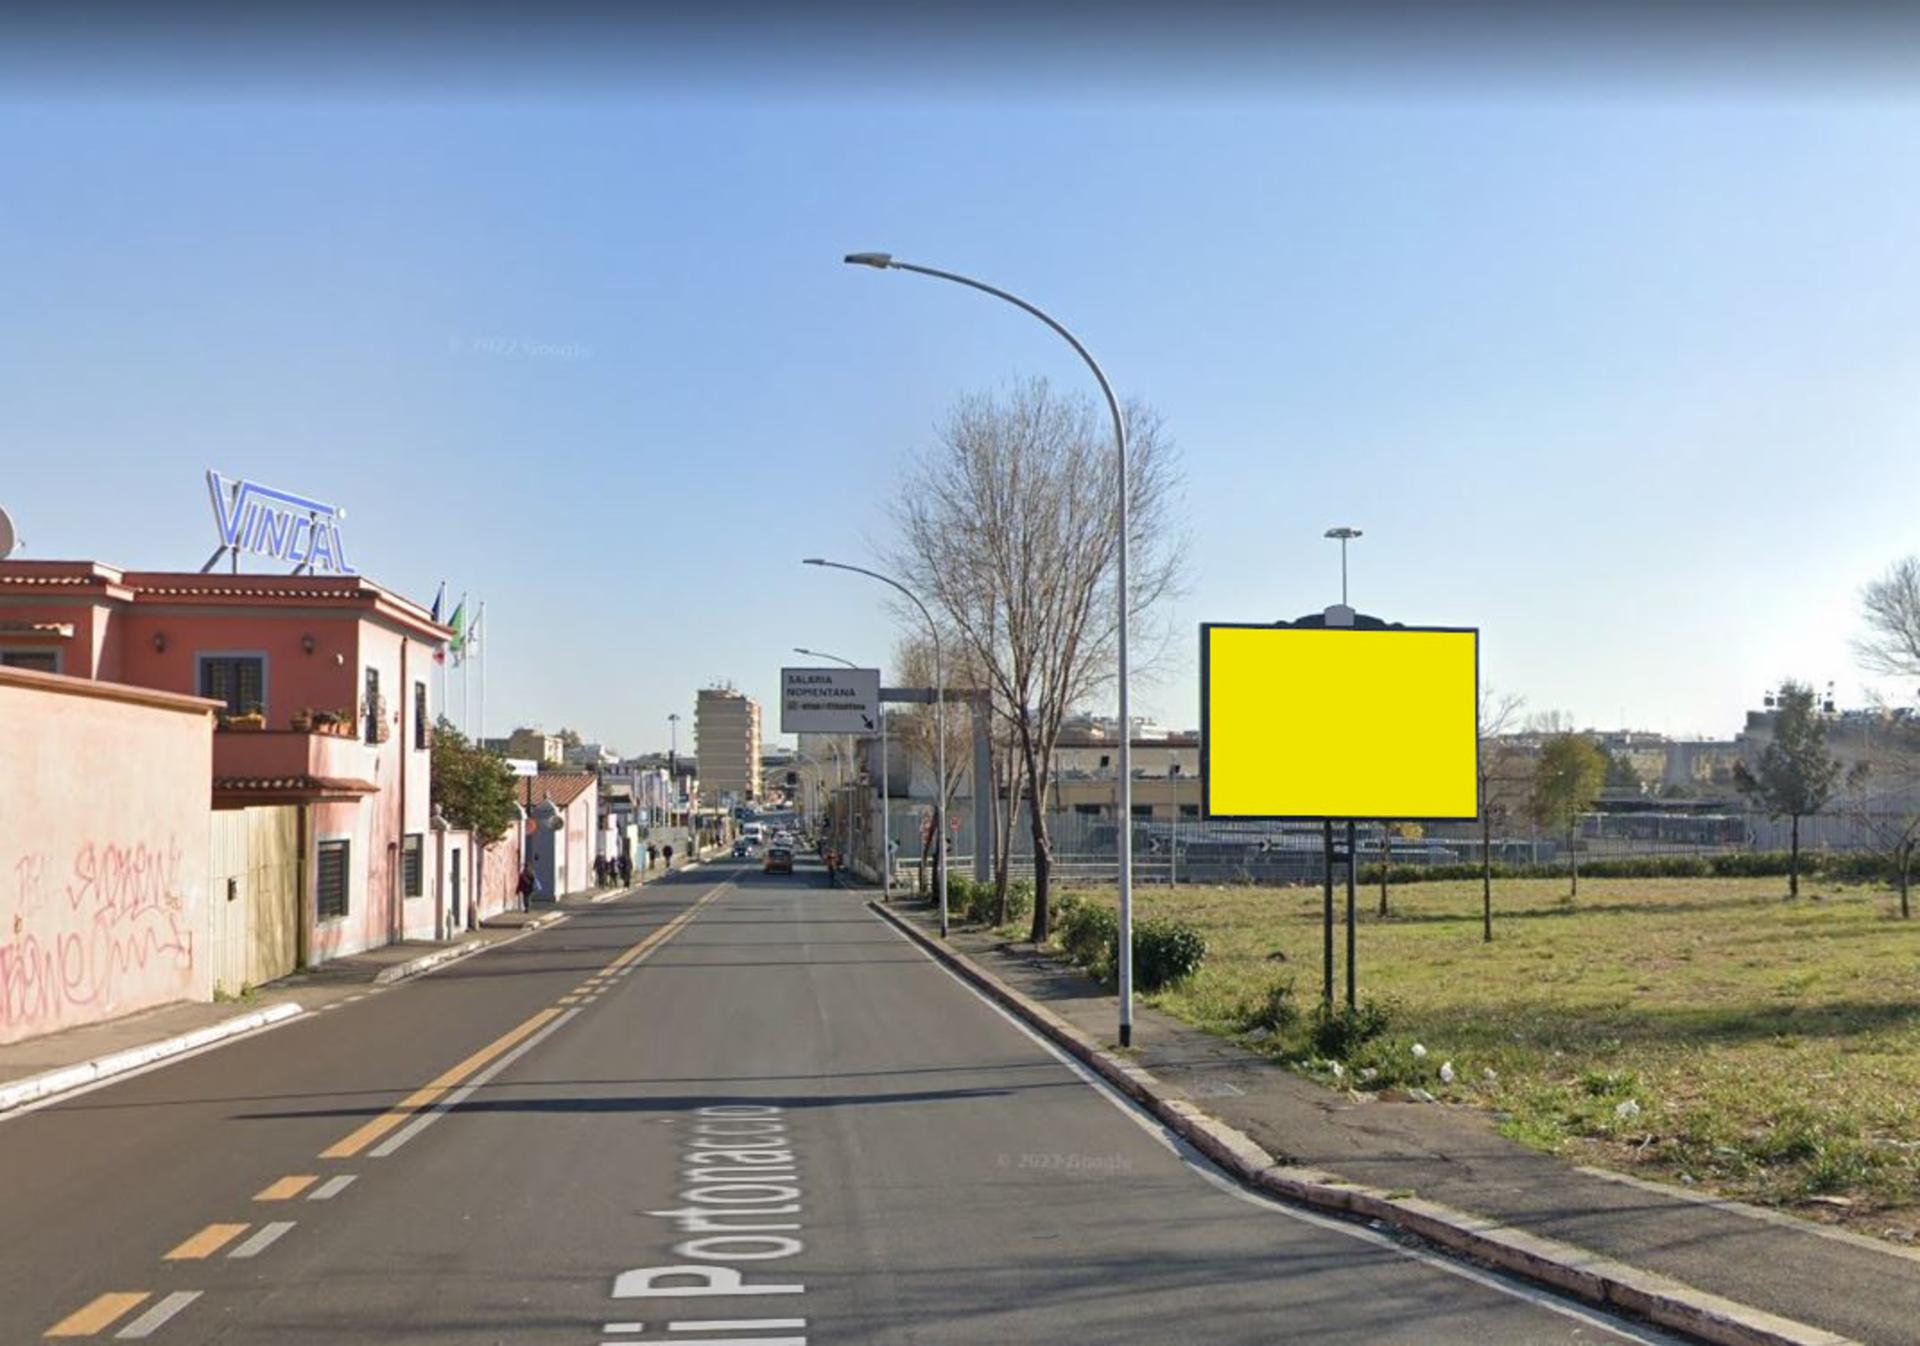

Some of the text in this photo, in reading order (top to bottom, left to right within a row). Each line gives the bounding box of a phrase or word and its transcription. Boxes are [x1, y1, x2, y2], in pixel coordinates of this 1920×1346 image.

[206, 469, 357, 575] VINCAL
[788, 675, 833, 684] SALARIA
[786, 687, 857, 697] NOMENTANA
